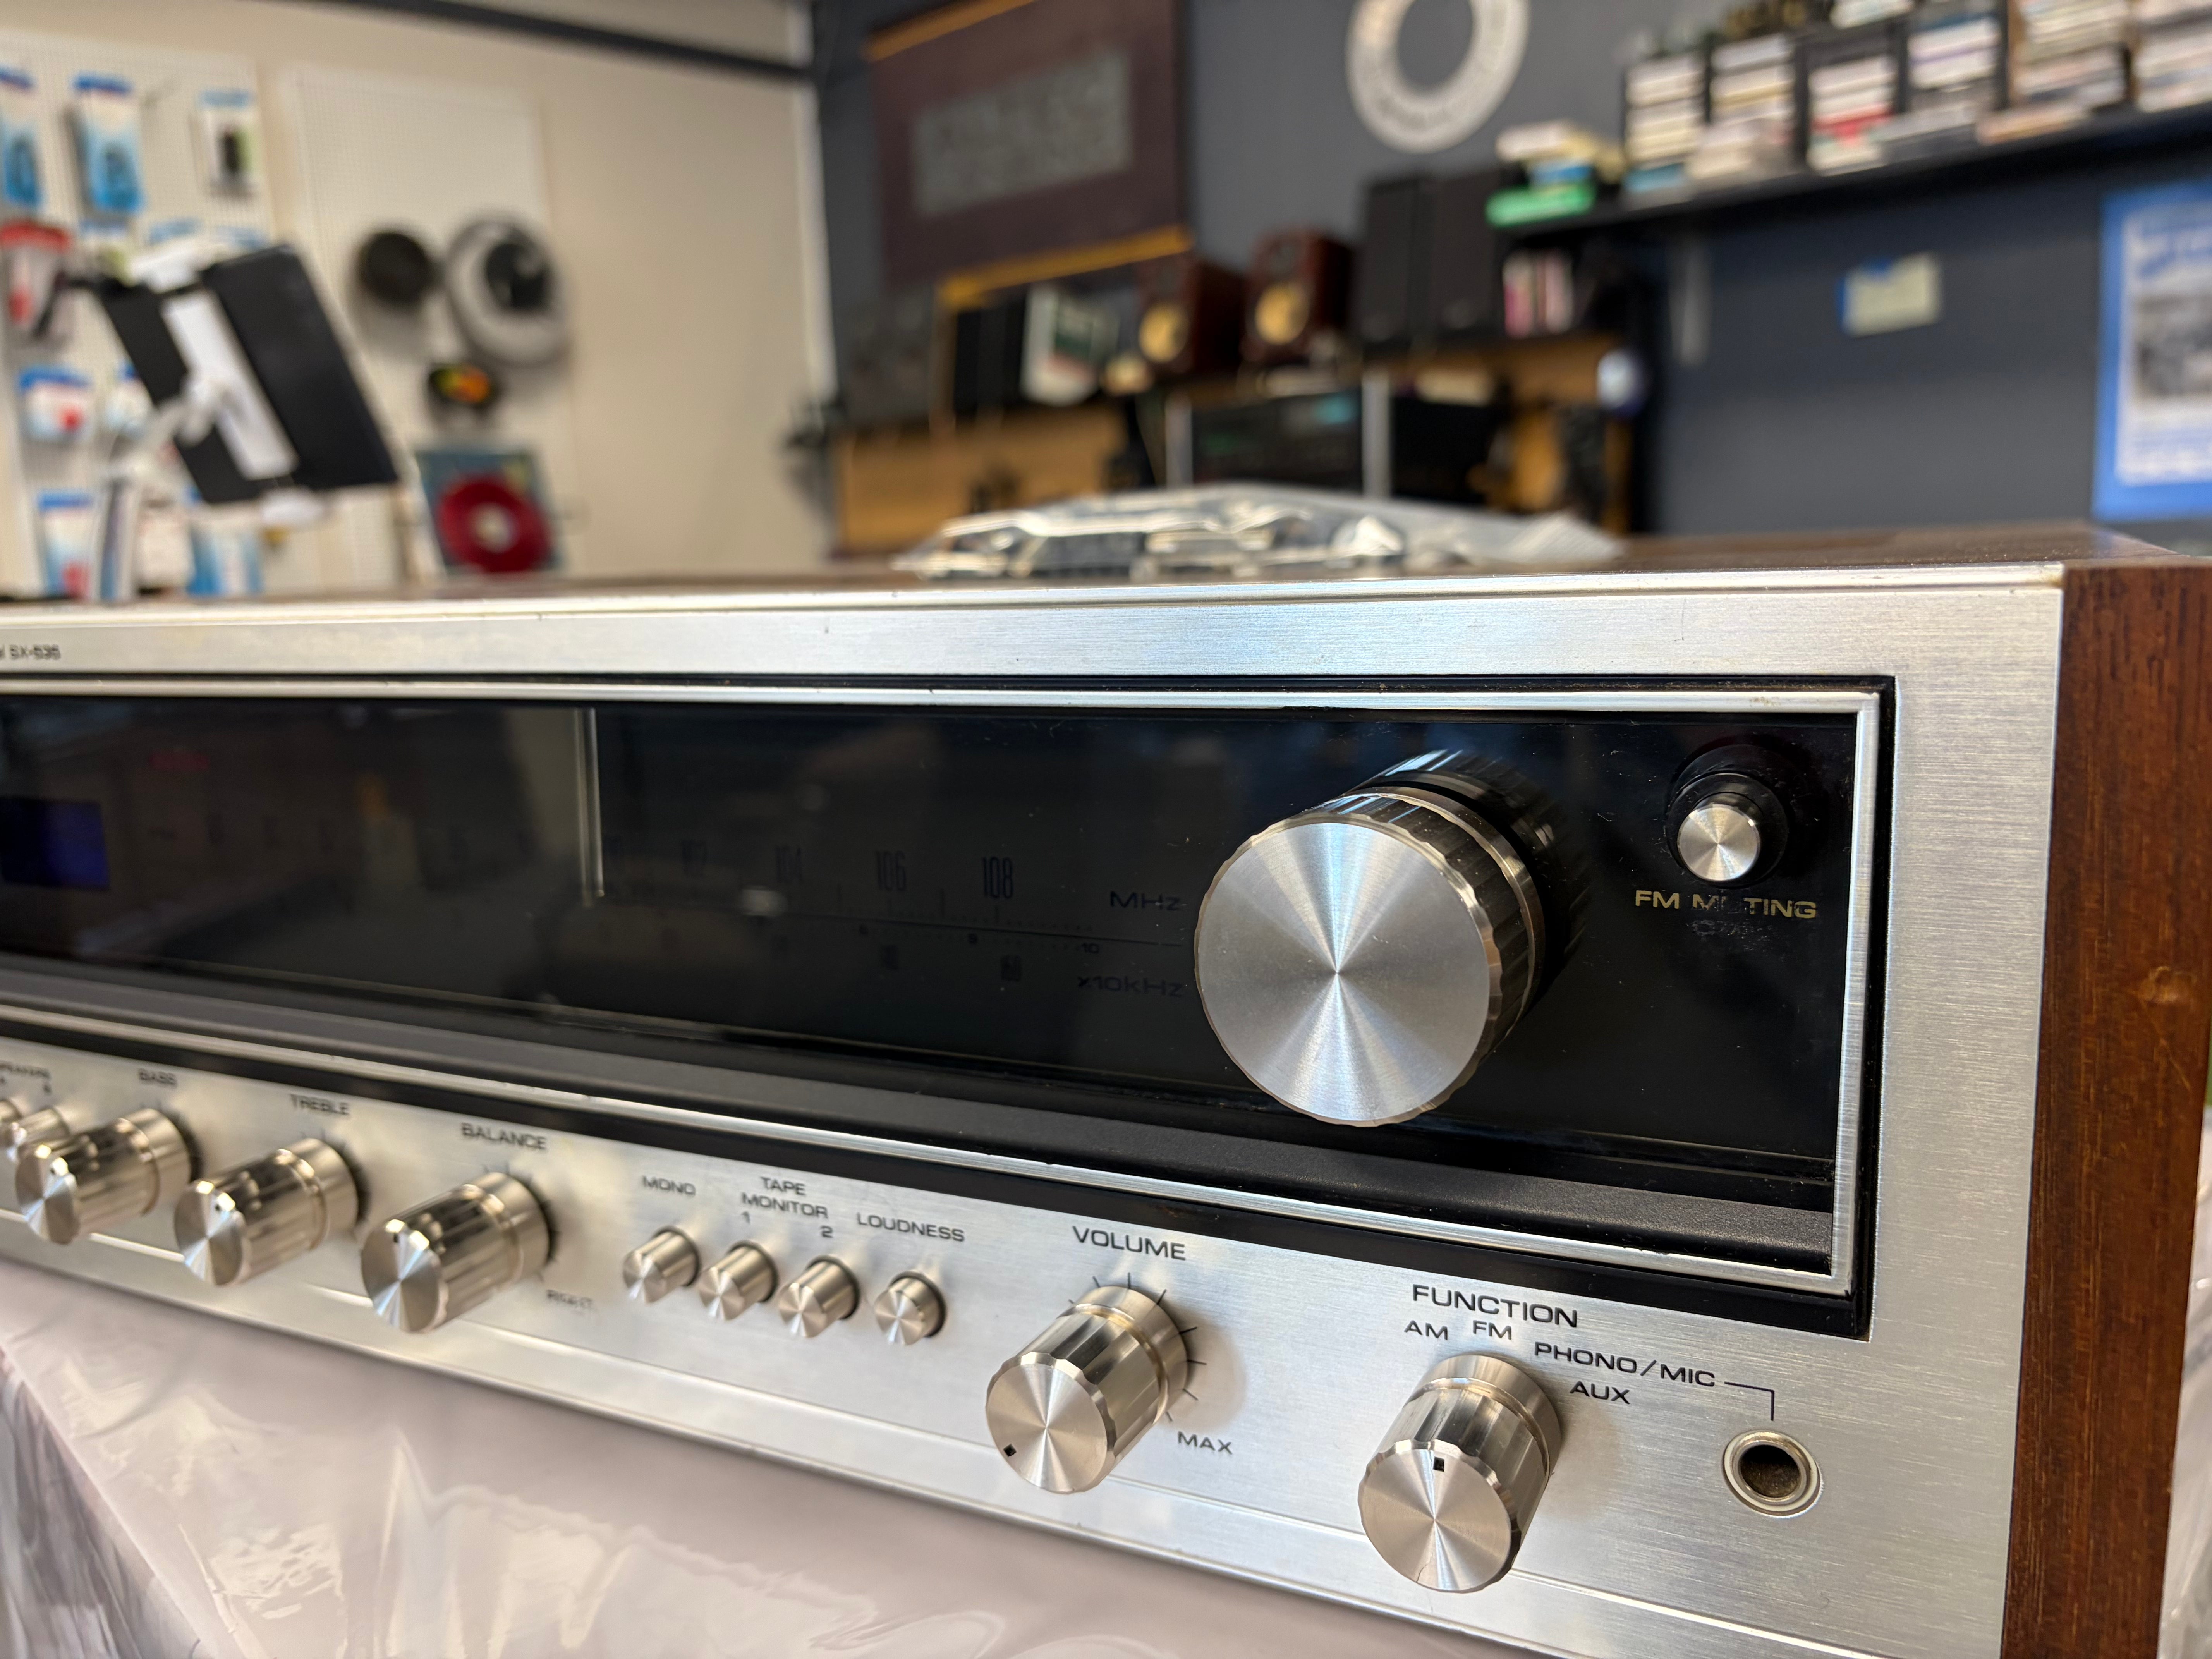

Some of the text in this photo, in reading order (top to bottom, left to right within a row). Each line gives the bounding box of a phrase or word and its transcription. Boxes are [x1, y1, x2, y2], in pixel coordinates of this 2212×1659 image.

[874, 850, 907, 891] 106
[982, 856, 1013, 899] 108
[1109, 891, 1181, 910] MHz
[1635, 890, 1680, 909] FM
[138, 1068, 177, 1085] BASS
[290, 1094, 350, 1115] TREBLE
[461, 1123, 546, 1150] BALANCE
[642, 1176, 696, 1196] MONO
[760, 1177, 805, 1196] TAPE
[741, 1192, 828, 1219] MONITOR
[741, 1211, 751, 1223] 1
[857, 1213, 965, 1242] LOUDNESS
[821, 1226, 833, 1238] 2
[1072, 1226, 1186, 1261] VOLUME
[1413, 1284, 1578, 1328] FUNCTION
[1405, 1321, 1512, 1340] AM FM
[1535, 1342, 1715, 1387] PHONO/MIC
[1570, 1381, 1630, 1405] AUX
[1178, 1431, 1233, 1455] MAX
